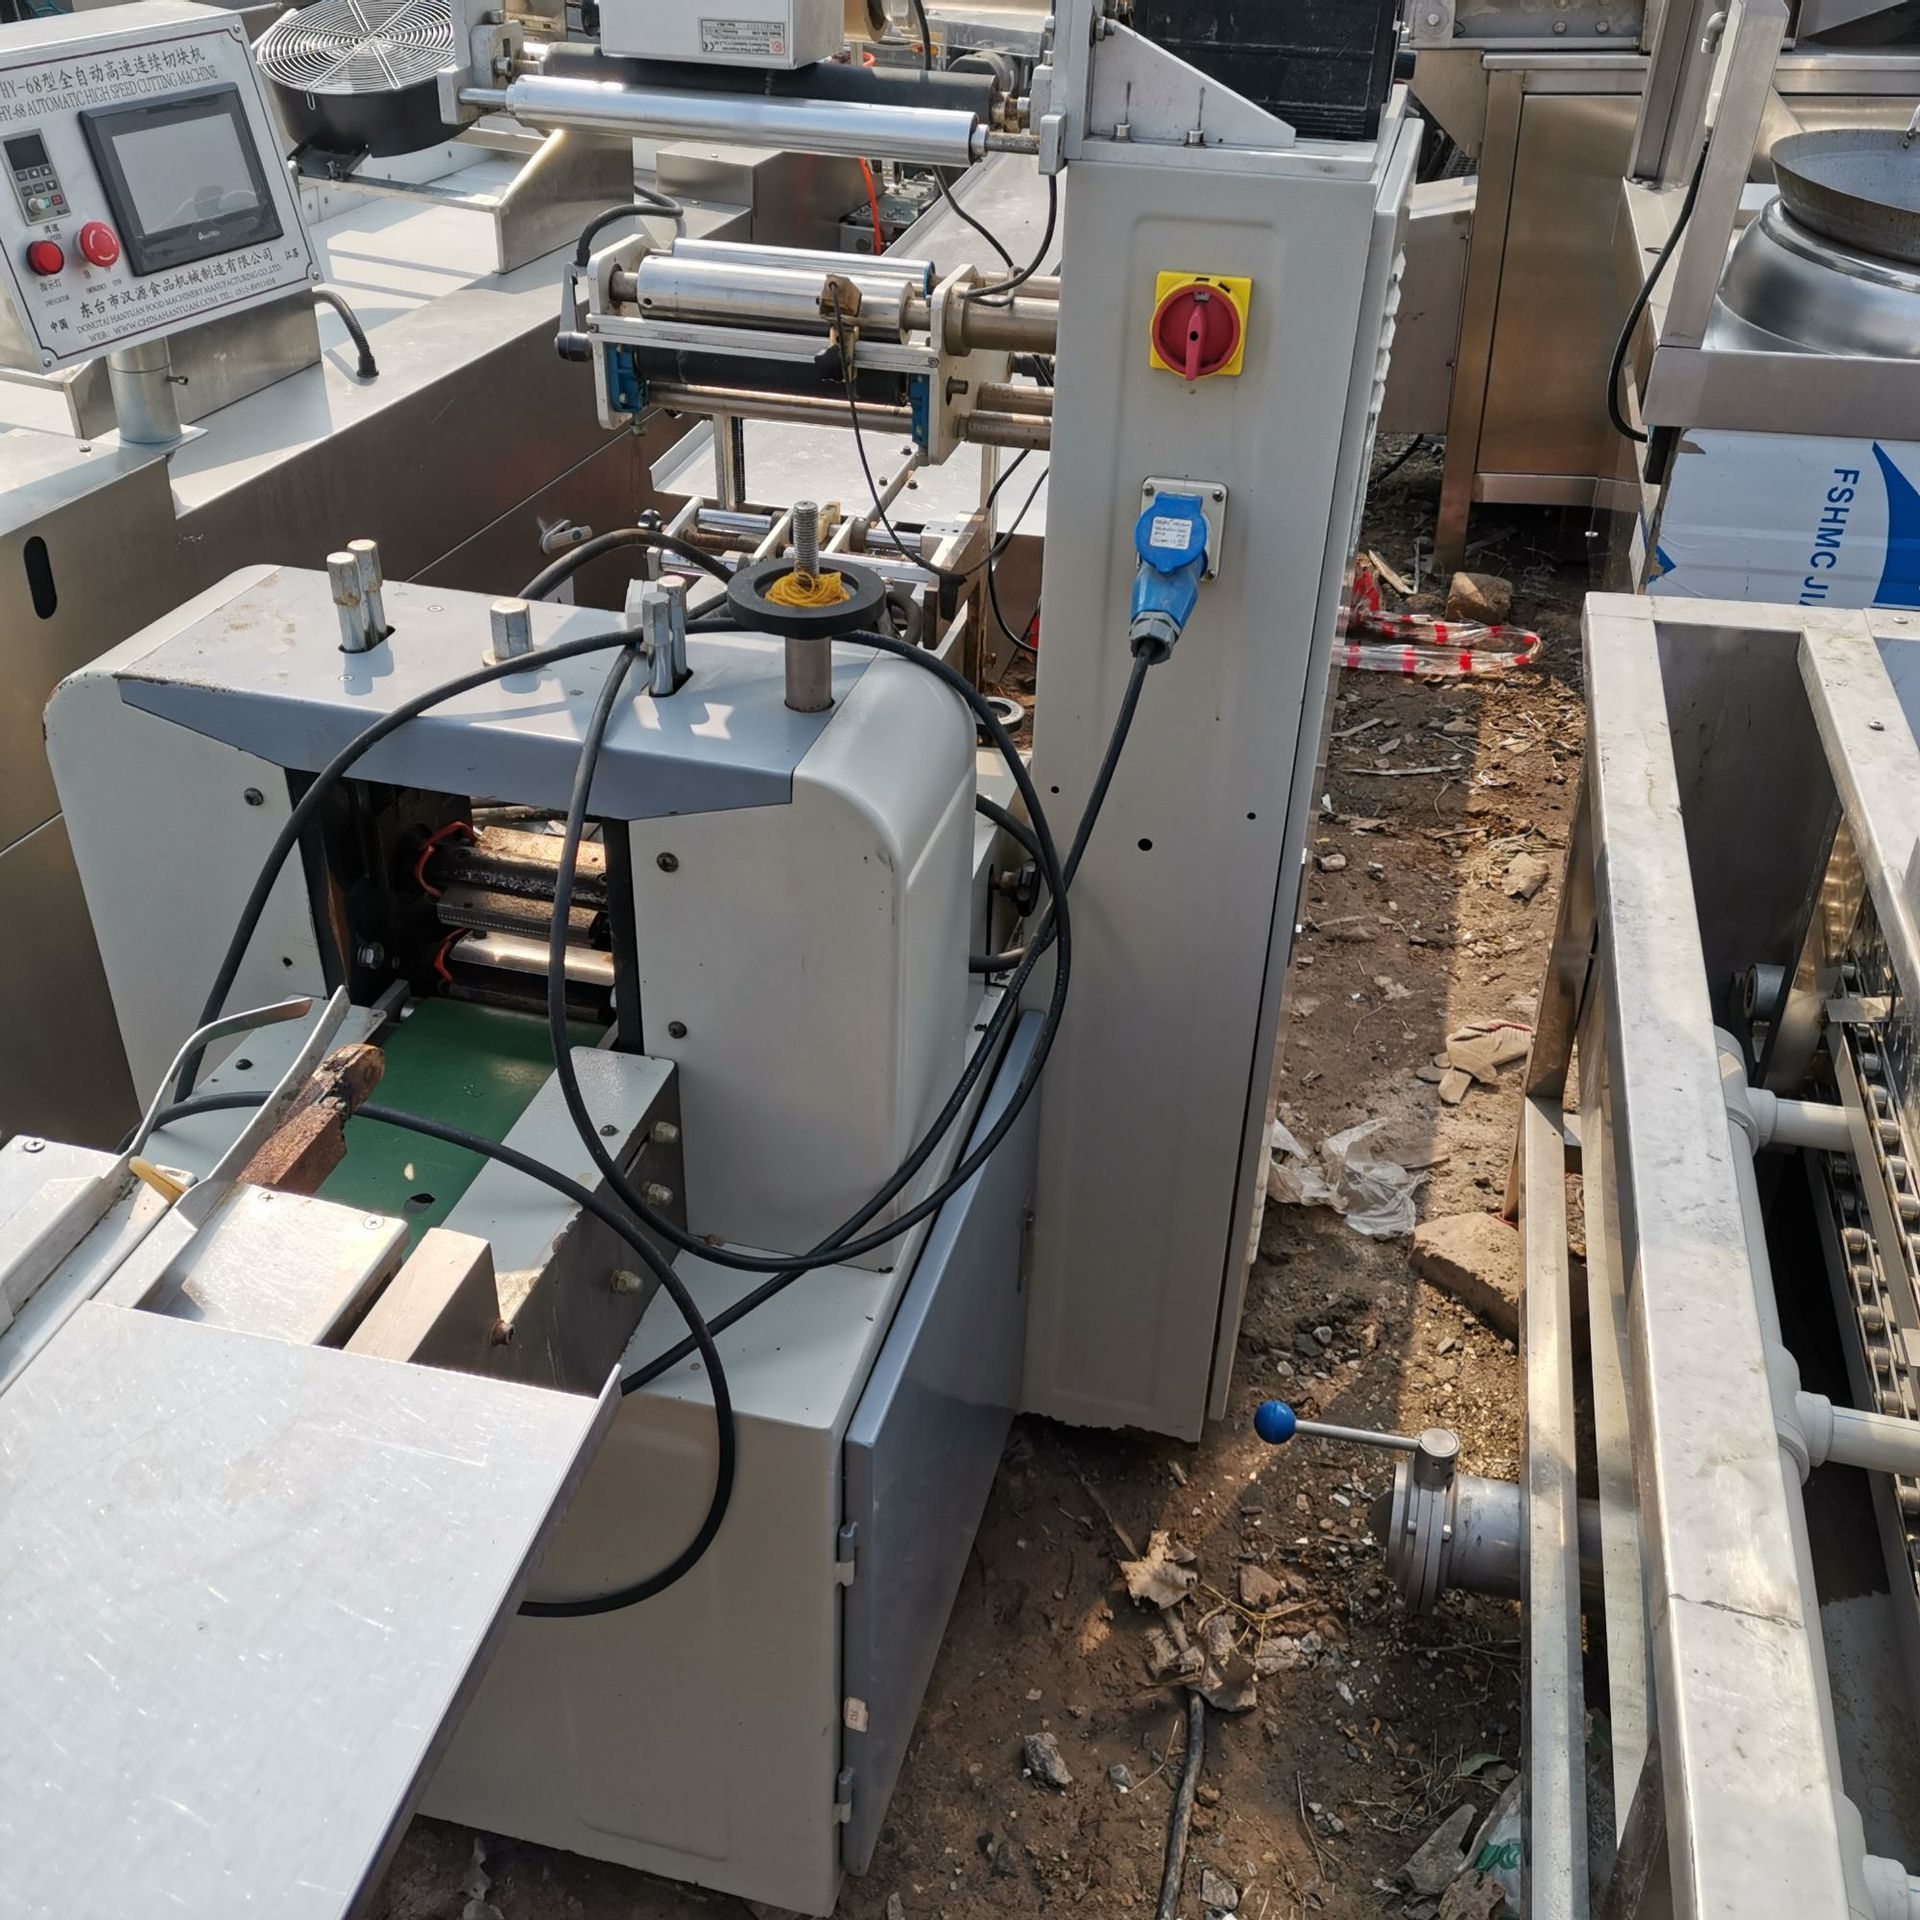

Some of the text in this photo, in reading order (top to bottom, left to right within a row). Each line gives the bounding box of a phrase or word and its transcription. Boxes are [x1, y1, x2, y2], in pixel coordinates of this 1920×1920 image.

[27, 91, 86, 116] AUTOMATIC
[84, 85, 111, 104] HIGH
[109, 80, 138, 99] SPEED
[137, 71, 179, 93] CUTTING
[176, 64, 218, 85] MACHINE
[80, 247, 273, 318] 东台市汉源食品机械制造有限公司
[50, 318, 69, 333] 中国
[1799, 468, 1860, 606] FSHMC JI
